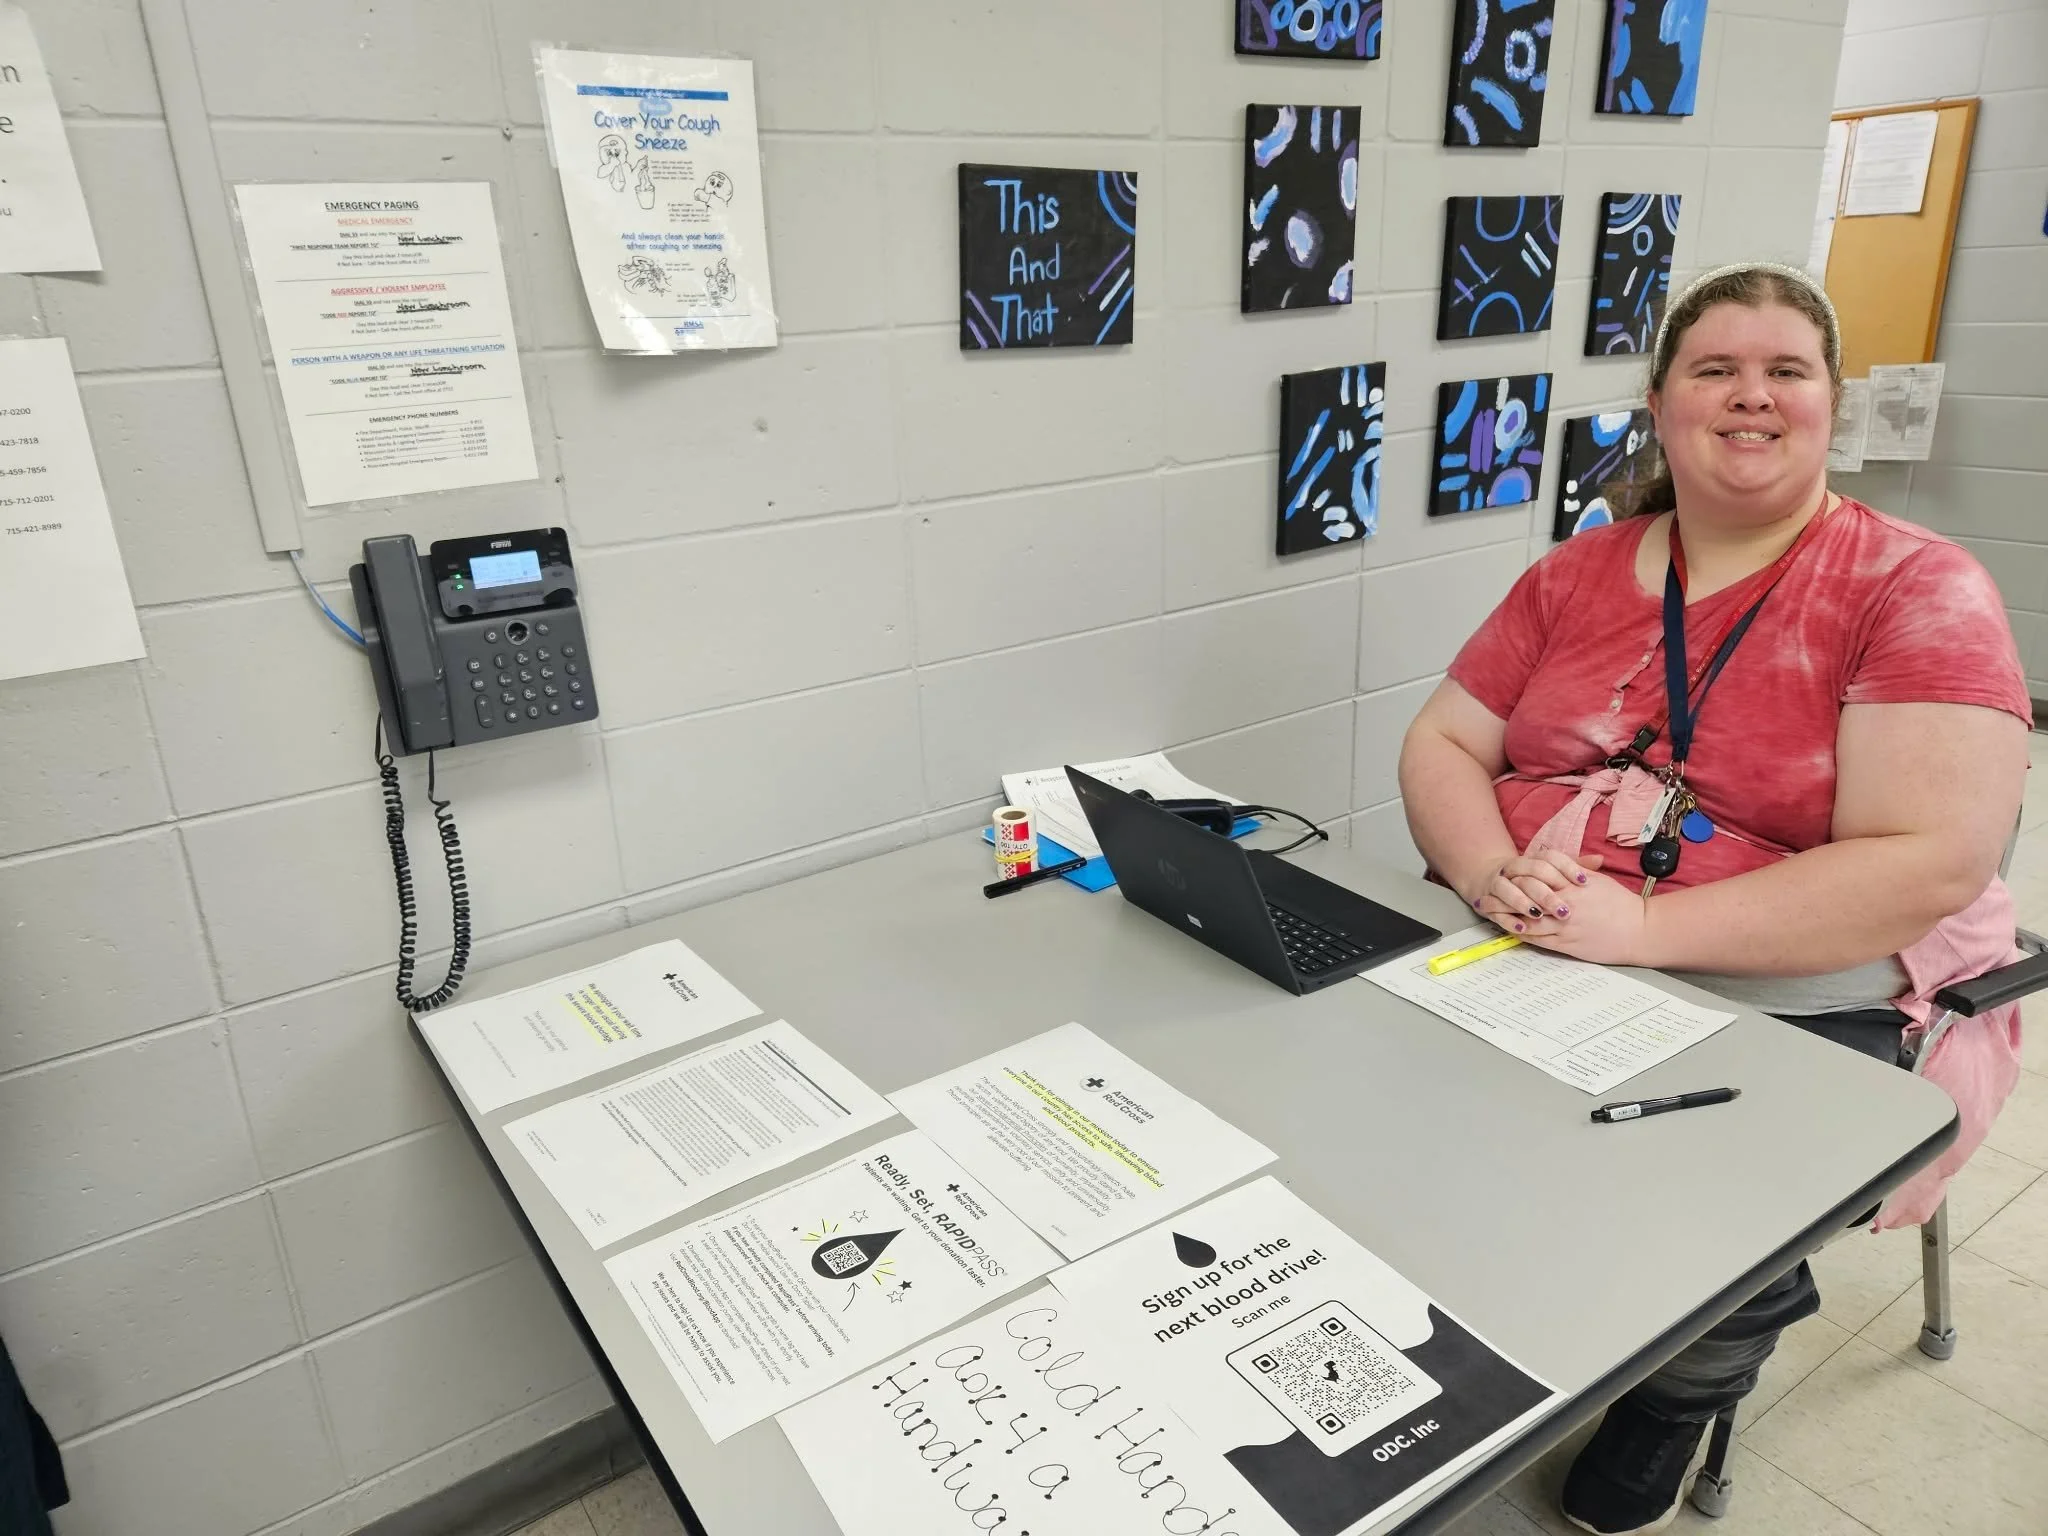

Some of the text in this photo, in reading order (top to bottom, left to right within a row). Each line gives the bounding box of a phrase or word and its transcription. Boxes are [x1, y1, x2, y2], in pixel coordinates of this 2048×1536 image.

[594, 111, 721, 135] Cover Your Cough
[635, 134, 688, 151] Sneeze
[325, 200, 419, 211] EMERGENCY PAGING
[337, 216, 413, 226] MEDICAL EMERGENCY
[983, 179, 1059, 235] This
[621, 232, 635, 240] And
[638, 232, 662, 242] always
[665, 232, 683, 240] clean
[686, 233, 702, 242] your
[626, 242, 646, 251] after
[649, 242, 679, 252] coughing
[692, 243, 722, 252] sneezing
[1010, 242, 1060, 285] And
[331, 286, 373, 296] AGGRESSIVE
[381, 284, 409, 294] VIOLENT
[411, 283, 447, 292] EMPLOYEE
[991, 292, 1059, 343] That
[291, 356, 320, 365] PERSON
[323, 355, 341, 363] WITH
[350, 352, 381, 360] WEAPON
[423, 345, 470, 355] THREATENING
[471, 343, 505, 352] SITUATION
[0, 407, 31, 416] 7-0200
[369, 410, 459, 423] EMERGENCY PHONE NUMBERS
[668, 981, 690, 1001] Red Cross
[676, 979, 698, 998] American
[1020, 1070, 1036, 1083] Thank
[1033, 1081, 1047, 1090] you
[1051, 1095, 1074, 1111] joining
[1089, 1122, 1113, 1139] mission
[1111, 1138, 1131, 1152] today
[1136, 1157, 1159, 1174] ensure
[1102, 1093, 1145, 1123] Red Cross
[1112, 1091, 1153, 1119] American
[1002, 1066, 1027, 1084] everyone
[1031, 1088, 1042, 1096] our
[1040, 1095, 1062, 1111] country
[1061, 1110, 1073, 1120] has
[1071, 1119, 1093, 1134] access
[1098, 1139, 1112, 1151] safe,
[1113, 1149, 1144, 1173] lifesaving
[1143, 1171, 1164, 1187] blood
[1041, 1106, 1095, 1148] and blood products.
[874, 1154, 909, 1190] Ready,
[909, 1189, 934, 1213] Set,
[953, 1193, 980, 1220] Red Cross
[960, 1192, 987, 1216] American
[861, 1162, 985, 1287] Patients are waiting. Get to your donation faster.
[722, 1229, 736, 1242] please
[733, 1242, 750, 1259] proceed
[750, 1264, 759, 1272] our
[1142, 1235, 1291, 1314] Sign up for the
[1153, 1249, 1328, 1343] next blood drive!
[1231, 1295, 1291, 1329] Scan me
[657, 1271, 664, 1280] We
[661, 1279, 669, 1287] are
[667, 1286, 676, 1298] here
[685, 1314, 694, 1323] Let
[690, 1322, 698, 1330] us
[695, 1328, 707, 1343] know
[705, 1347, 716, 1357] you
[714, 1357, 735, 1384] experience
[657, 1288, 669, 1303] issues
[666, 1303, 676, 1312] and
[672, 1311, 680, 1320] we
[683, 1327, 691, 1335] be
[688, 1334, 701, 1350] happy
[702, 1356, 715, 1372] assist
[1005, 1308, 1240, 1536] Cold Hand
[1372, 1419, 1440, 1462] ODC. Inc
[872, 1361, 1029, 1536] Handwa
[1004, 1412, 1048, 1454] 4
[1028, 1463, 1070, 1500] a
